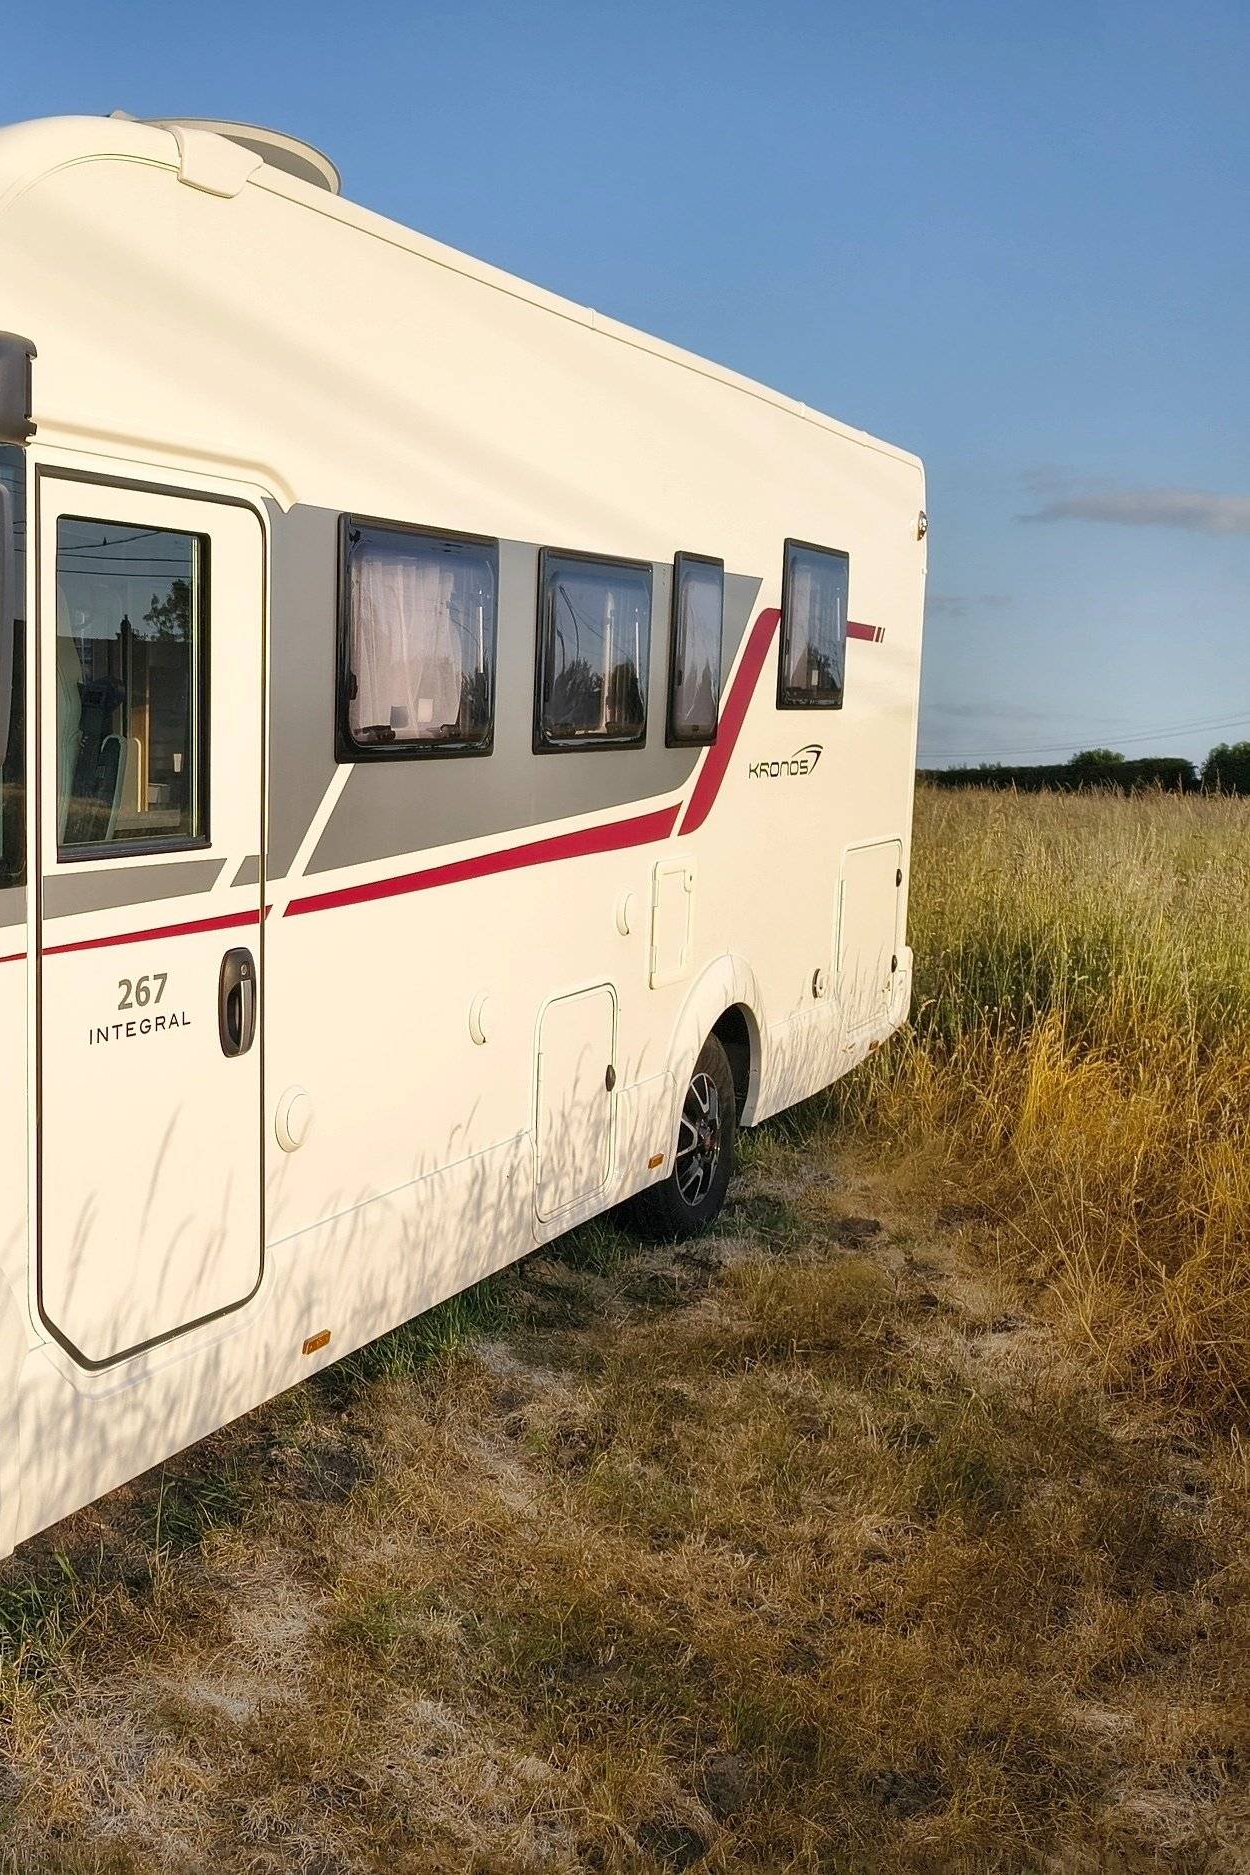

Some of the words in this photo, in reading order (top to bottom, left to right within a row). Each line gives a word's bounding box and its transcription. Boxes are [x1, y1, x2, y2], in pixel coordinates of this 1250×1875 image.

[749, 759, 809, 779] KRONOS
[118, 973, 168, 1011] 267
[89, 1011, 191, 1045] INTEGRAL
